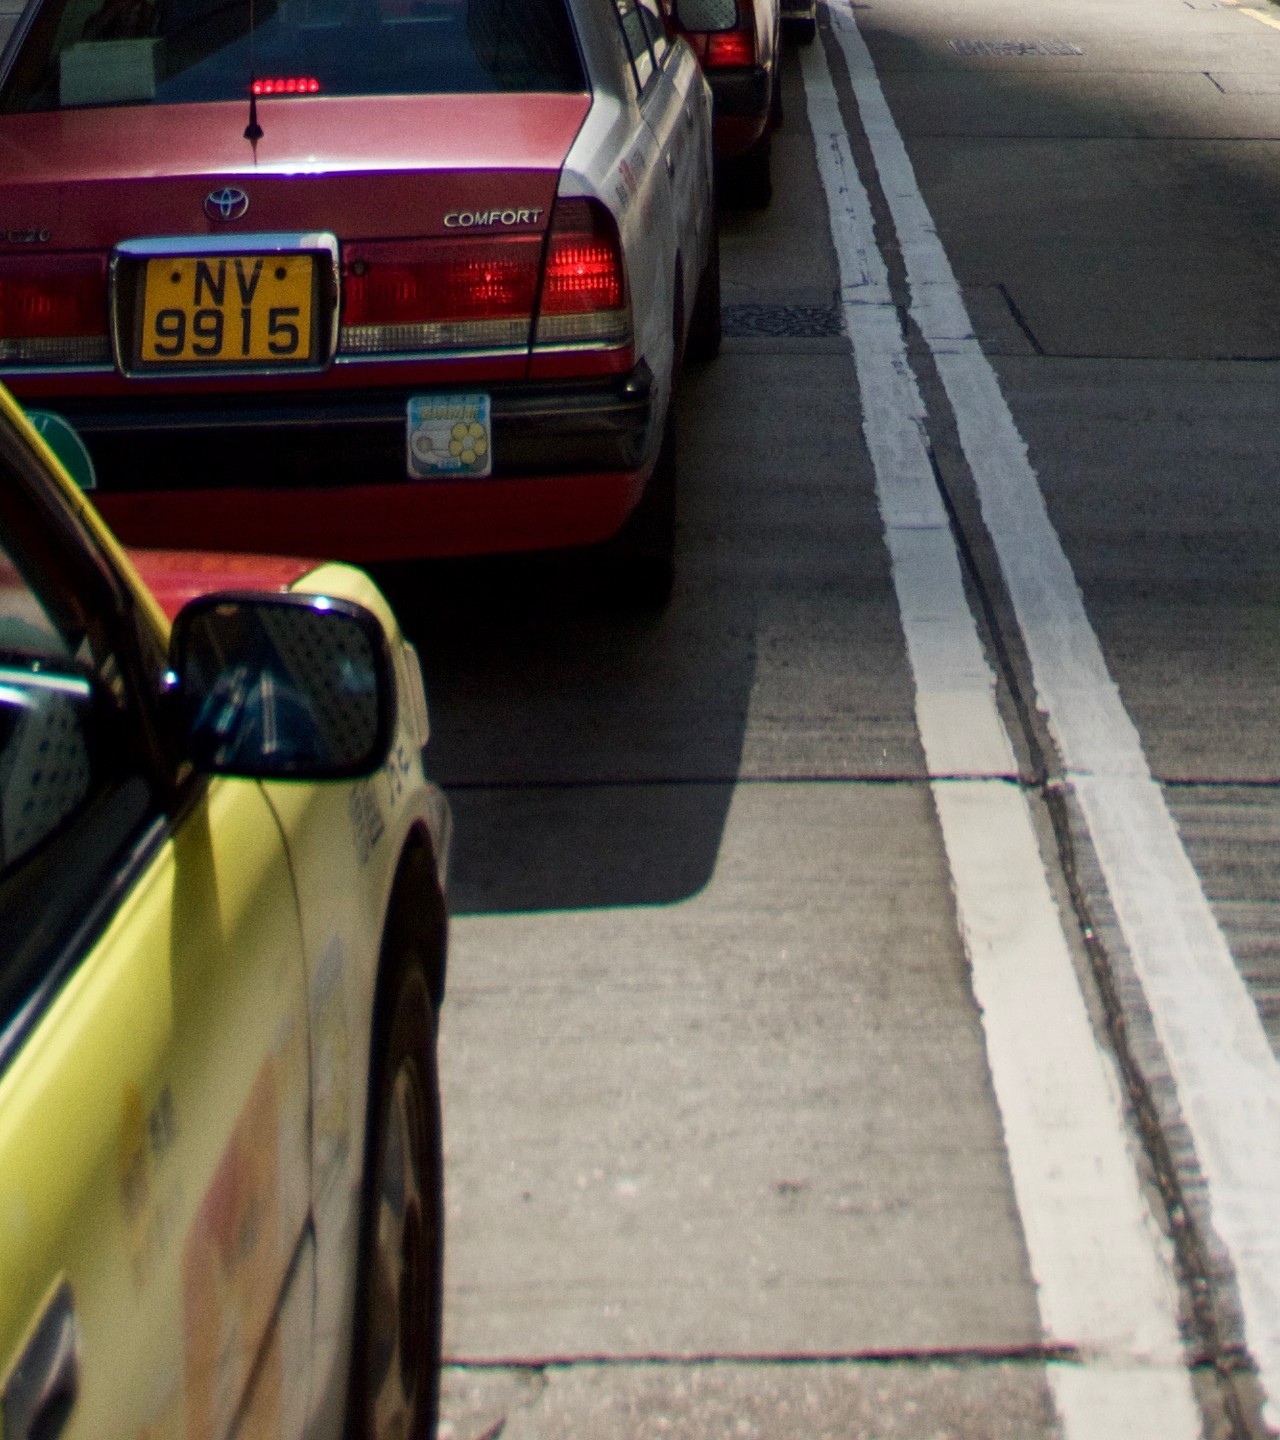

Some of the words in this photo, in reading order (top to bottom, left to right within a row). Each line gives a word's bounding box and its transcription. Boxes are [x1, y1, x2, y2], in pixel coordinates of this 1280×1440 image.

[443, 208, 543, 229] COMFORT
[193, 260, 265, 307] NV
[153, 306, 301, 356] 9915
